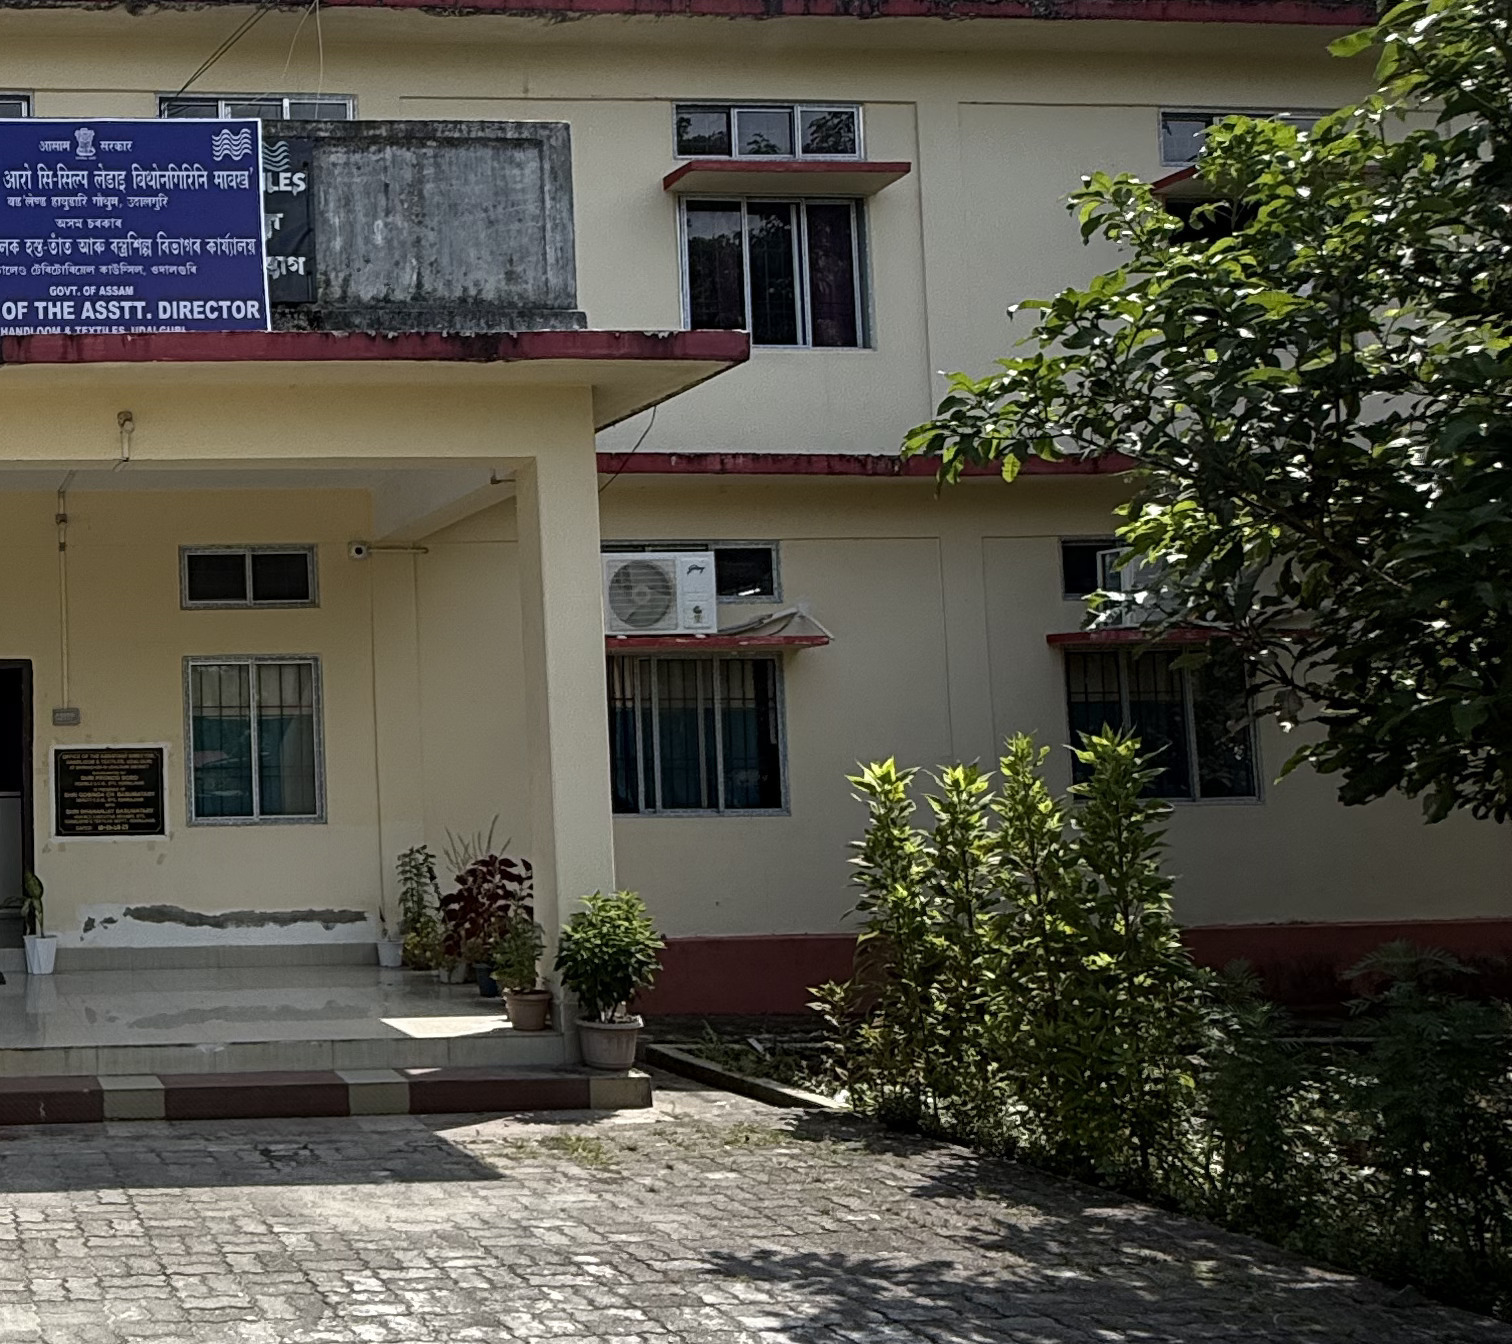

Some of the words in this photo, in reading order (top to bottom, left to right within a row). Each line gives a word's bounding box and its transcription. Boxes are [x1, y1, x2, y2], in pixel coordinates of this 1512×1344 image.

[39, 140, 70, 153] आसाम
[100, 140, 132, 153] सरकार
[3, 163, 32, 190] आरो
[55, 218, 83, 229] অসম
[87, 218, 122, 229] চৰকাৰ
[78, 238, 105, 255] আৰু
[49, 286, 80, 296] GOVT.
[84, 286, 96, 296] OF
[99, 286, 134, 296] ASSAM
[2, 302, 28, 320] OF
[34, 301, 75, 320] THE
[81, 301, 152, 320] ASSTT.
[159, 301, 260, 320] DIRECTOR
